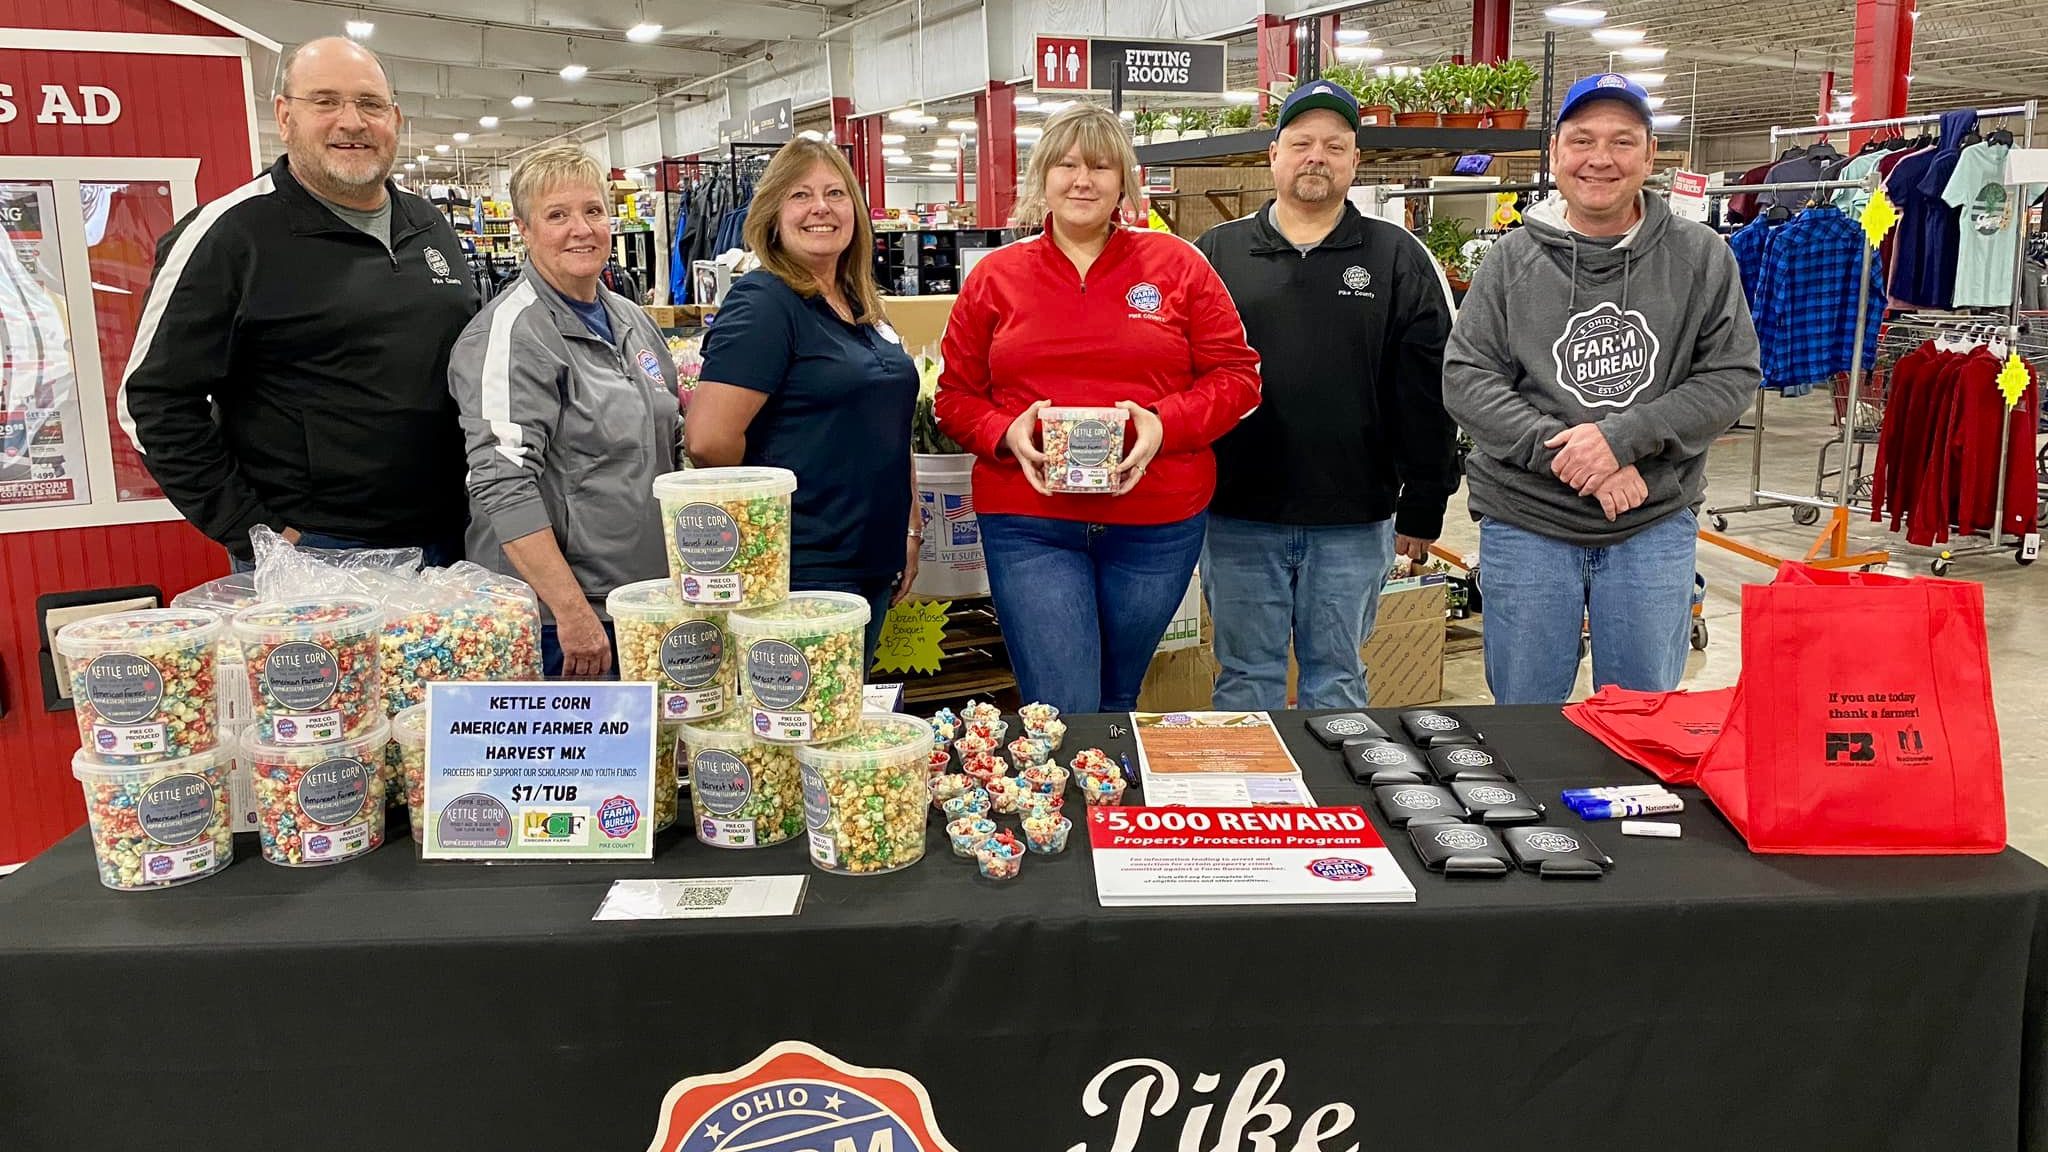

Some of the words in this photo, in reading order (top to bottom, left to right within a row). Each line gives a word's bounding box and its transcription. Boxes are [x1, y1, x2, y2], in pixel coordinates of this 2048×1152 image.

[1125, 49, 1191, 67] FITTING
[1128, 67, 1189, 84] ROOMS
[37, 85, 121, 124] AD
[1588, 318, 1612, 328] OHIO
[1573, 330, 1636, 361] FARM
[1576, 348, 1643, 382] BUREAU
[1616, 380, 1632, 392] 1919
[21, 481, 67, 492] POPCORN
[679, 516, 704, 529] KETTLE
[707, 515, 727, 528] CORN
[942, 551, 956, 560] WE
[889, 610, 918, 623] Dozen
[918, 608, 945, 623] Roses
[893, 624, 925, 637] Bouquet
[668, 633, 697, 648] KETTLE
[700, 630, 717, 642] CORN
[271, 655, 301, 668] KETTLE
[305, 652, 326, 665] CORN
[751, 650, 776, 666] KETTLE
[780, 654, 800, 667] CORN
[92, 665, 122, 680] KETTLE
[127, 664, 151, 677] CORN
[490, 696, 546, 710] KETTLE
[552, 696, 591, 710] CORN
[1829, 693, 1838, 703] If
[1840, 694, 1865, 704] you
[1868, 694, 1886, 702] ate
[1888, 692, 1916, 704] today
[1829, 708, 1868, 719] thank
[1881, 707, 1920, 719] farmer!
[305, 720, 337, 729] PRODUCED
[450, 721, 527, 735] AMERICAN
[532, 721, 593, 735] FARMER
[598, 721, 630, 735] AND
[125, 733, 160, 741] PRODUCED
[486, 747, 555, 760] HARVEST
[560, 747, 586, 760] MIX
[443, 768, 475, 777] PROCEEDS
[476, 768, 492, 777] HELP
[493, 768, 523, 777] SUPPORT
[523, 768, 536, 777] OUR
[537, 768, 579, 777] SCHOLARSHIP
[580, 768, 594, 777] AND
[595, 768, 616, 777] YOUTH
[616, 768, 638, 777] FUNDS
[721, 761, 740, 774] CORN
[307, 771, 337, 786] KETTLE
[341, 766, 360, 779] CORN
[148, 788, 181, 804] KETTLE
[185, 782, 206, 796] CORN
[511, 783, 578, 803] $7/TUB
[604, 806, 632, 820] FARM
[1645, 803, 1679, 812] Nationwide
[146, 814, 179, 824] American
[447, 809, 478, 822] KETTLE
[483, 808, 504, 822] CORN
[605, 814, 635, 829] BUREAU
[1094, 812, 1211, 835] $5,000
[1213, 812, 1366, 832] REWARD
[1114, 836, 1189, 847] Property
[1193, 836, 1282, 845] Protection
[1286, 836, 1361, 847] Program
[1317, 863, 1358, 872] FARM
[1322, 867, 1366, 876] BUREAU
[731, 1087, 809, 1121] OHIO
[1066, 1058, 1361, 1152] Pike
